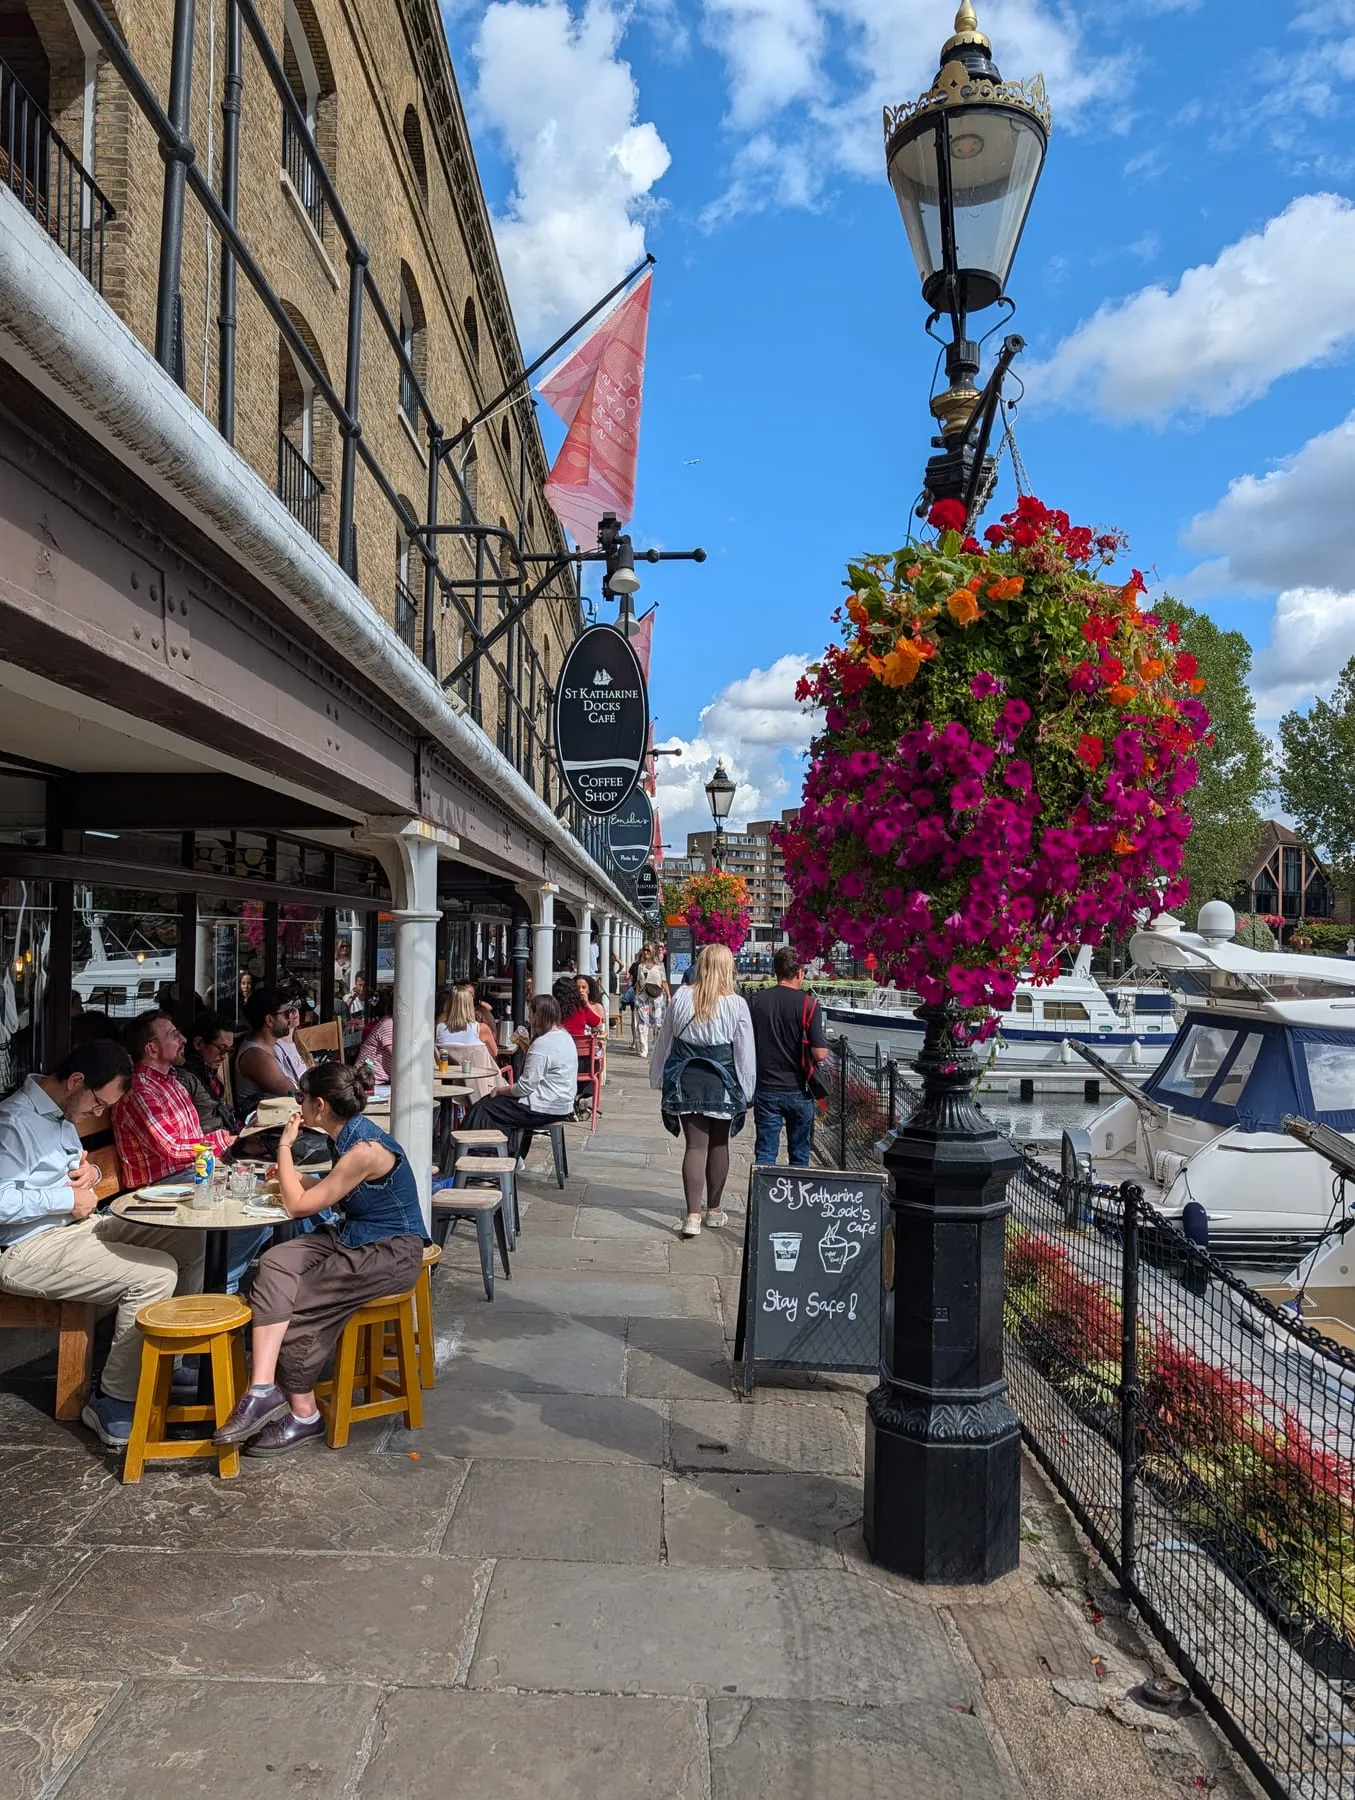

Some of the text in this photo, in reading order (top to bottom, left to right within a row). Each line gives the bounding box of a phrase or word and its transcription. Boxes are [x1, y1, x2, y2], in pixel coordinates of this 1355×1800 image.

[580, 688, 639, 699] KATHARINE
[584, 700, 621, 711] DOCKS
[588, 712, 616, 723] CAFÉ
[578, 774, 624, 788] COFFEE
[585, 789, 618, 802] SHOP
[769, 1177, 864, 1210] St Katharine
[820, 1202, 871, 1221] Dock's
[762, 1288, 799, 1322] Stay
